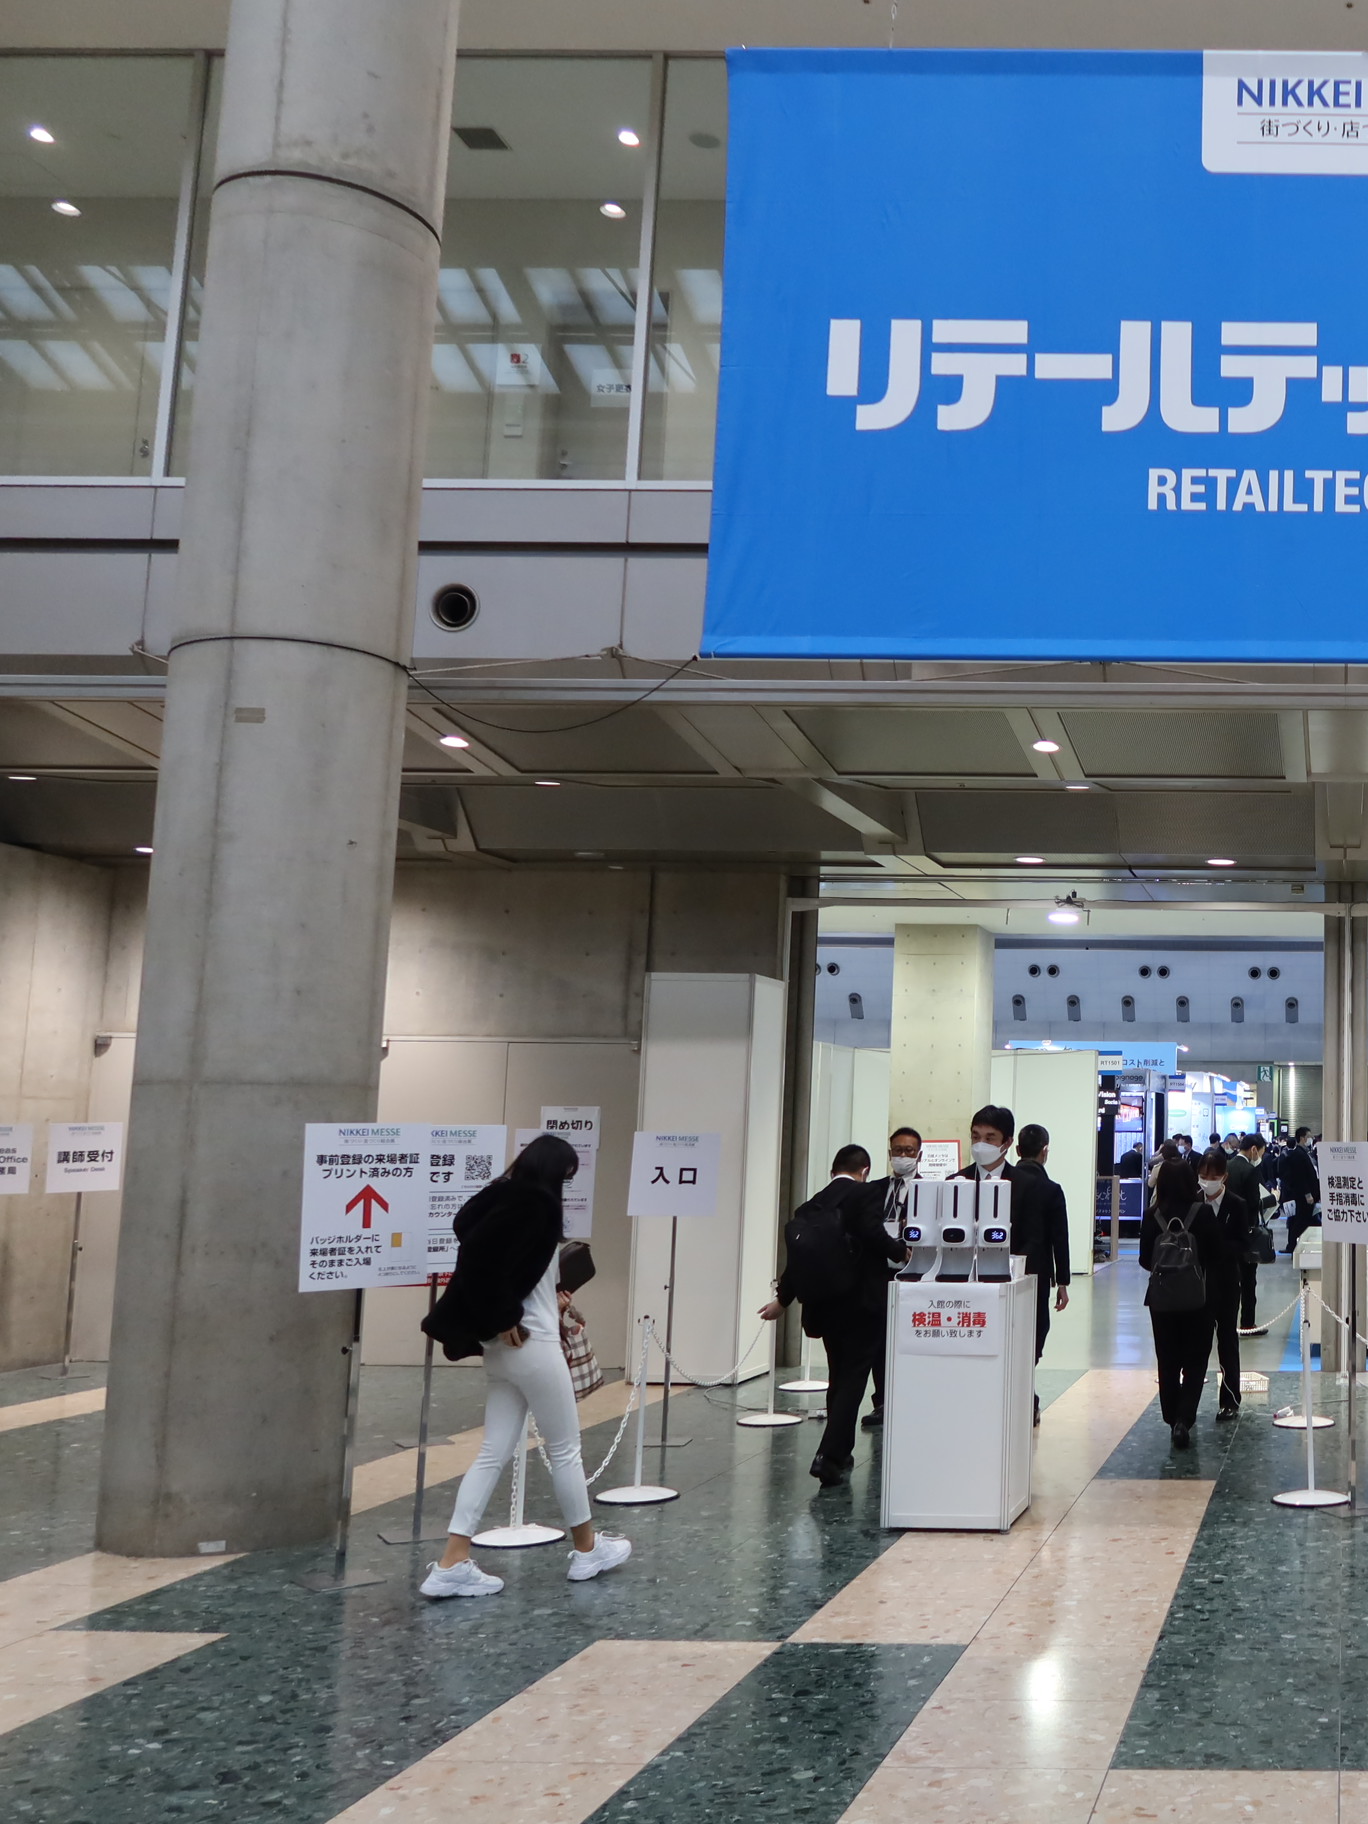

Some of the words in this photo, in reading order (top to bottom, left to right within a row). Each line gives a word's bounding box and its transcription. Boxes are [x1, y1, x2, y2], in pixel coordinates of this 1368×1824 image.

[1237, 78, 1362, 109] NIKKEI
[338, 1128, 370, 1137] NIKKEI
[371, 1127, 401, 1136] MESSE
[449, 1130, 477, 1138] MESSE
[57, 1149, 114, 1164] 講師受付
[316, 1152, 420, 1167] 事前登録の来場者証
[430, 1153, 455, 1167] 登録
[322, 1166, 414, 1179] プリント済みの方
[429, 1171, 454, 1183] です
[650, 1166, 698, 1185] 入口
[1327, 1175, 1364, 1190] 検温測定と
[1328, 1192, 1365, 1207] 手指消毒に
[310, 1233, 380, 1245] バッジホルダーに
[309, 1245, 382, 1257] 来場者証を入れて
[309, 1257, 372, 1269] そのままご入場
[308, 1270, 348, 1281] ください。
[928, 1299, 971, 1309] 入館の際に
[911, 1311, 987, 1328] 検温・消毒
[914, 1329, 984, 1338] をお願い致します
